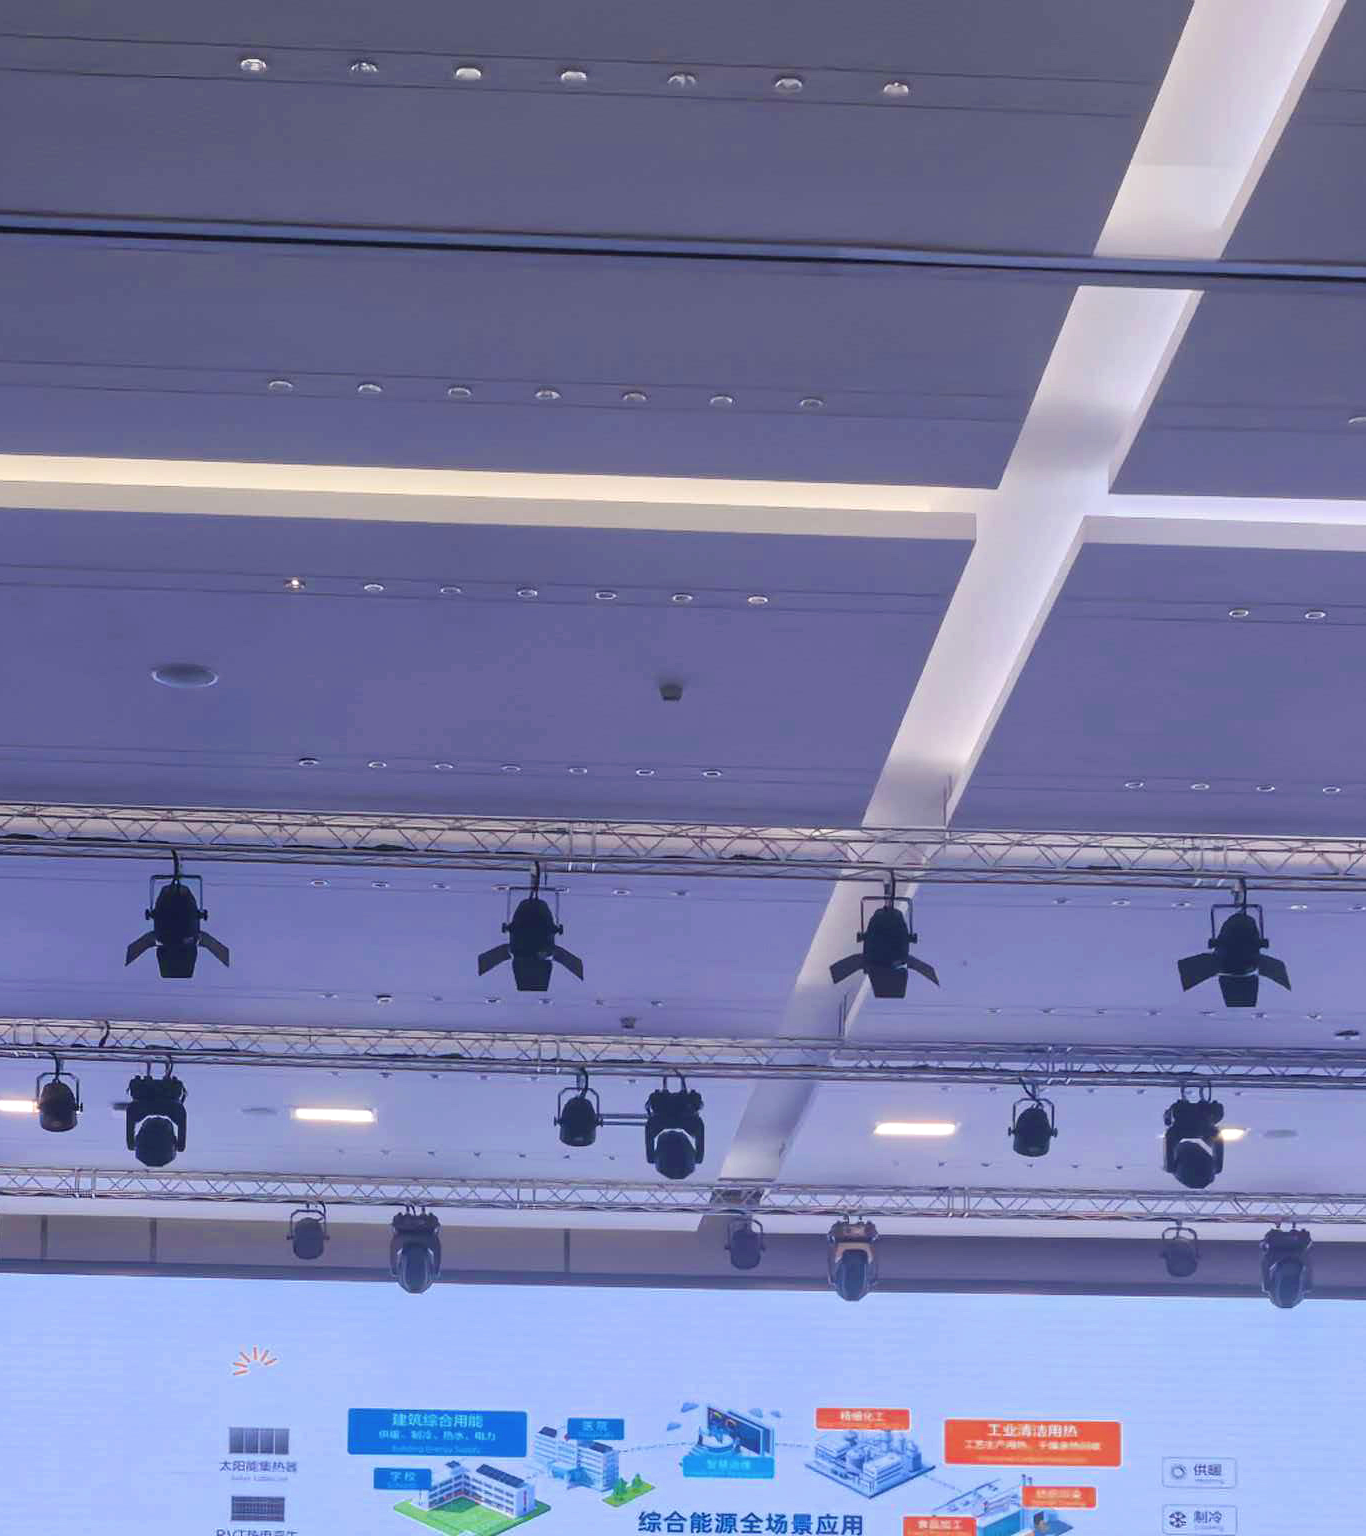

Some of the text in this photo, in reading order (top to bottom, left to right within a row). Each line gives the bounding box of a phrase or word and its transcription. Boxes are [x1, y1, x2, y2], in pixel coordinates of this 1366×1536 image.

[392, 1413, 484, 1428] 建筑综合用能
[987, 1423, 1078, 1438] 工业清洁用热
[219, 1461, 297, 1473] 太阳能集热器
[1194, 1464, 1222, 1476] 供暖
[638, 1511, 864, 1536] 综合能源全场景应用
[1194, 1511, 1222, 1523] 制冷
